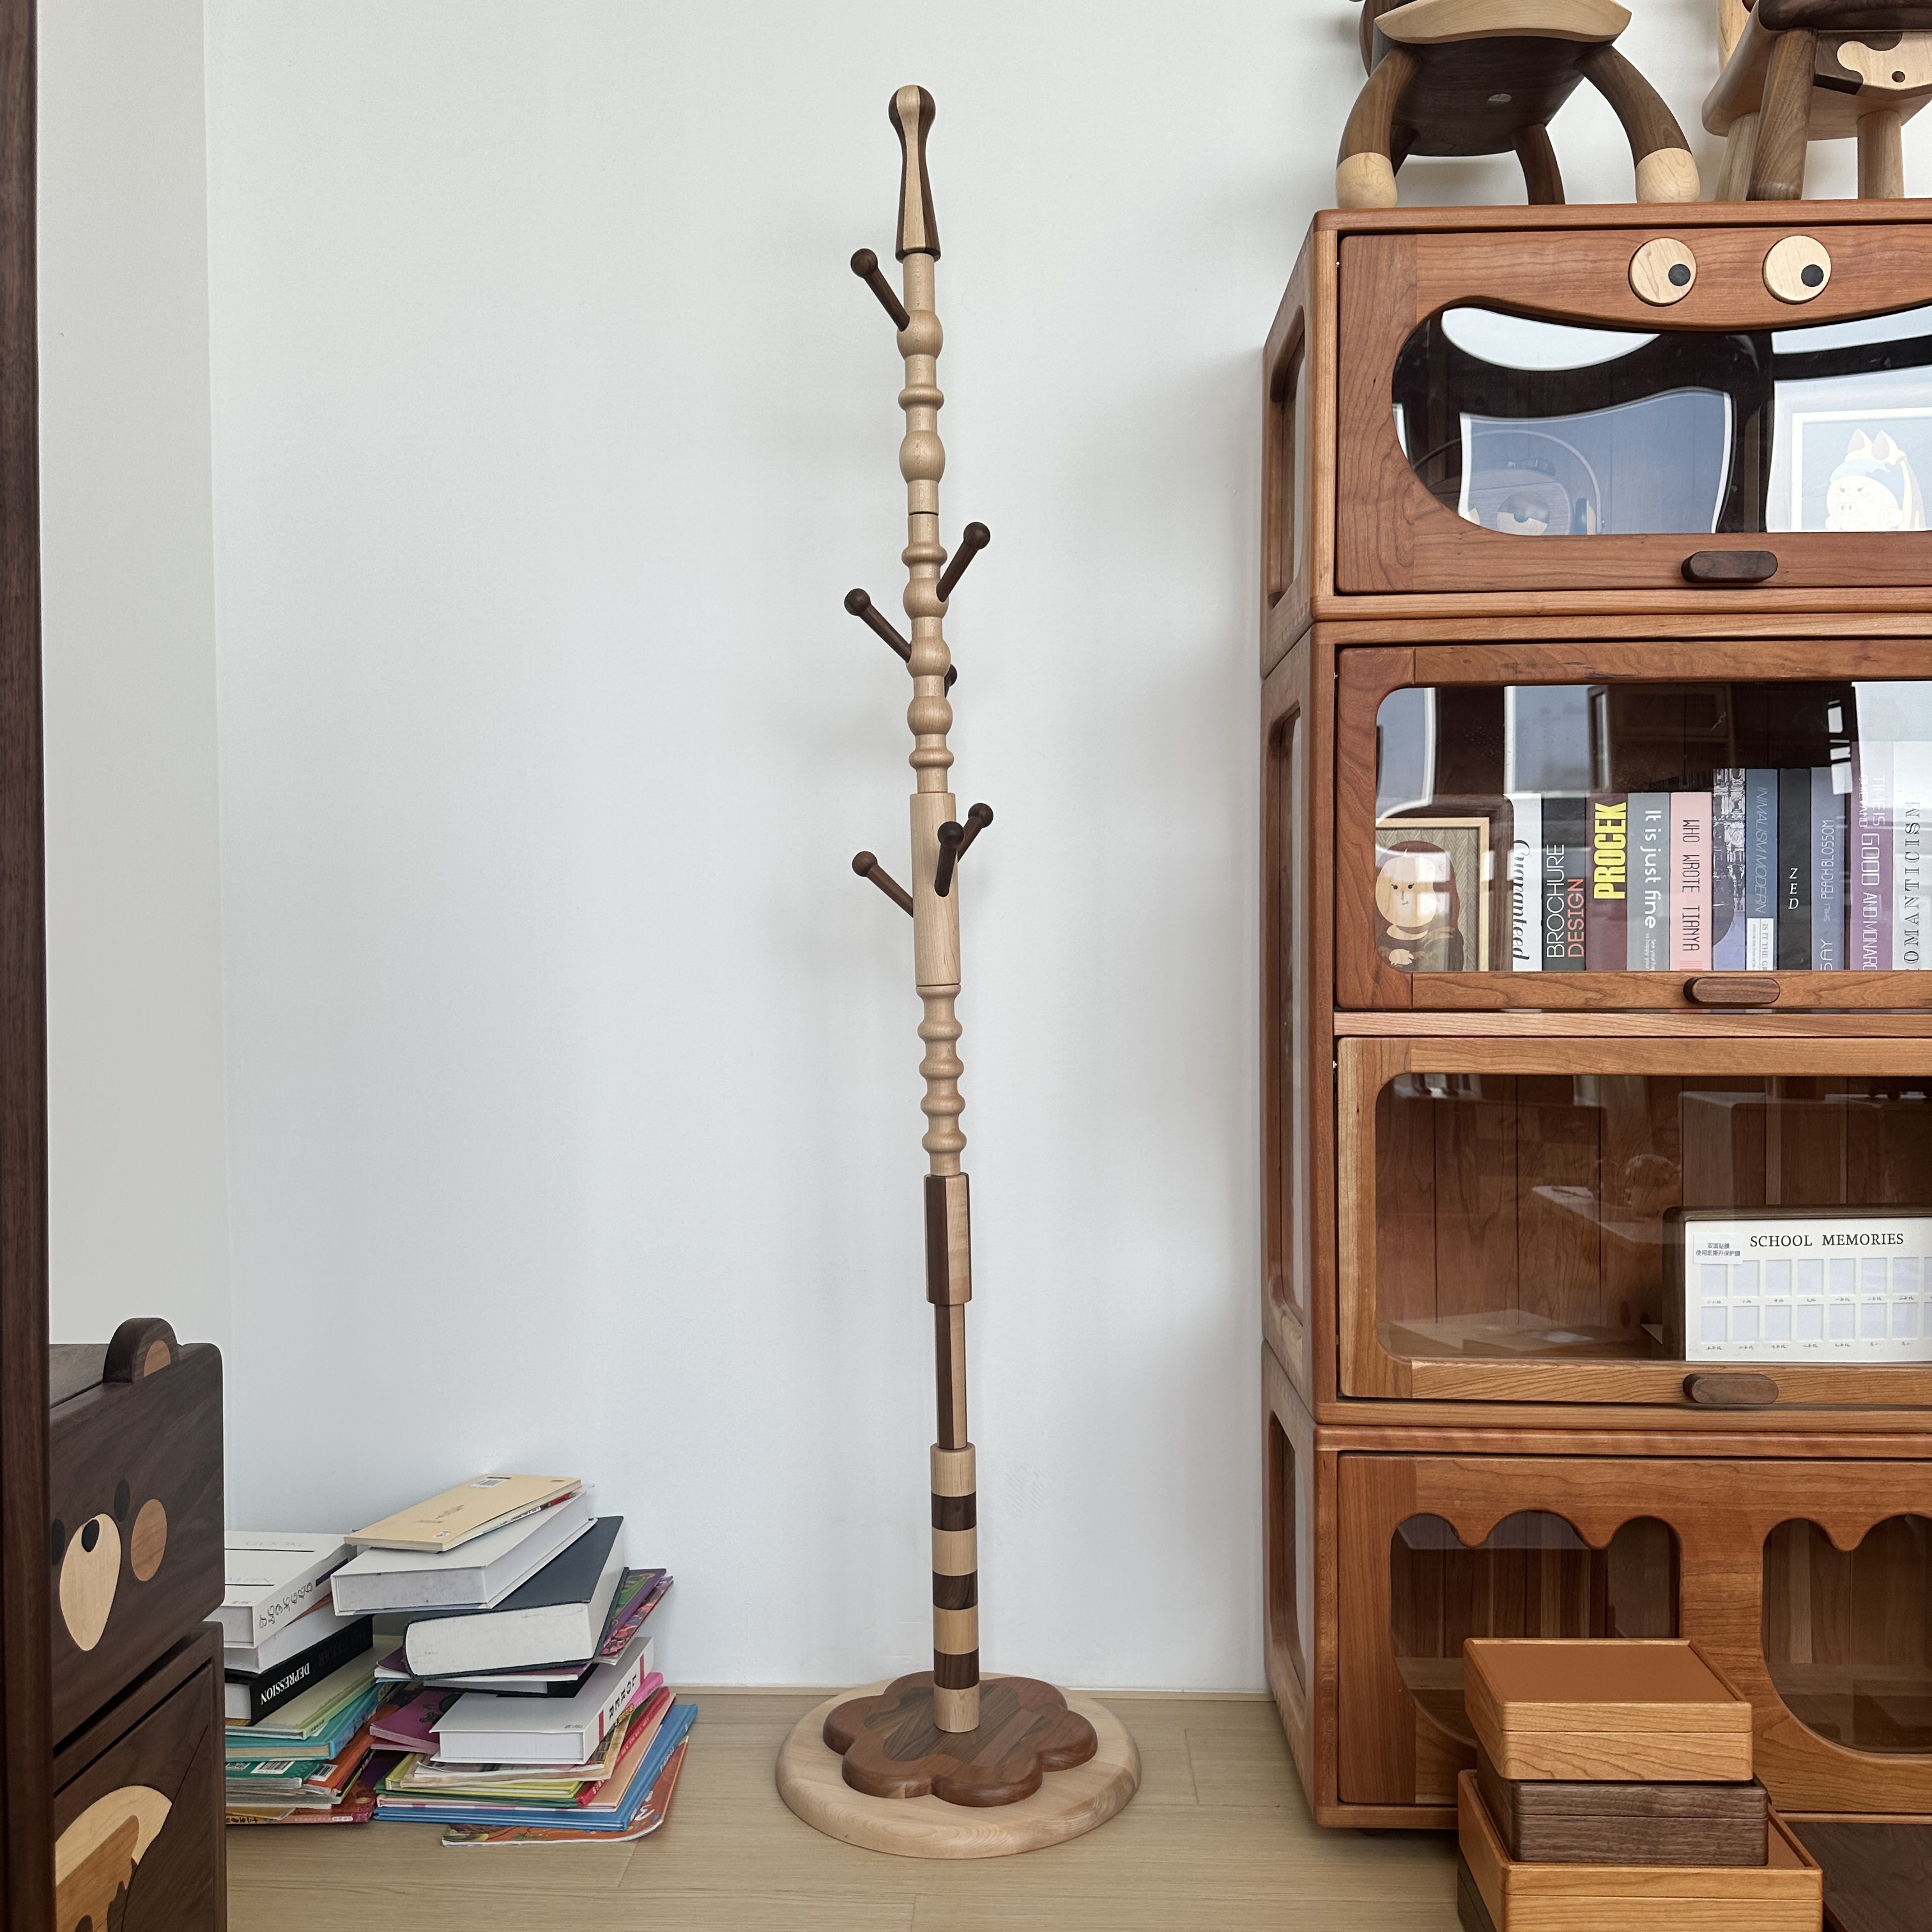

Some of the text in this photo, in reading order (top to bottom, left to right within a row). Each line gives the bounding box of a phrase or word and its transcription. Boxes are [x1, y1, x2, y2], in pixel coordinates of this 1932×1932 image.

[1873, 774, 1885, 810] TIME
[1593, 802, 1627, 900] PROCEK
[1640, 809, 1661, 929] It is just fine
[1821, 819, 1834, 866] BLOSSOM
[1861, 832, 1880, 885] GOOD
[1545, 844, 1565, 958] BROCHURE
[1682, 819, 1700, 951] WHO WROTE TIANYA
[1754, 855, 1768, 914] MODERN
[1821, 869, 1834, 900] PEACH
[1862, 892, 1878, 917] AND
[1903, 799, 1920, 970] OMANTICISM
[1567, 878, 1585, 958] DESIGN
[1750, 1232, 1905, 1248] SCHOOL MEMORIES
[260, 1662, 310, 1705] DEPRESSION
